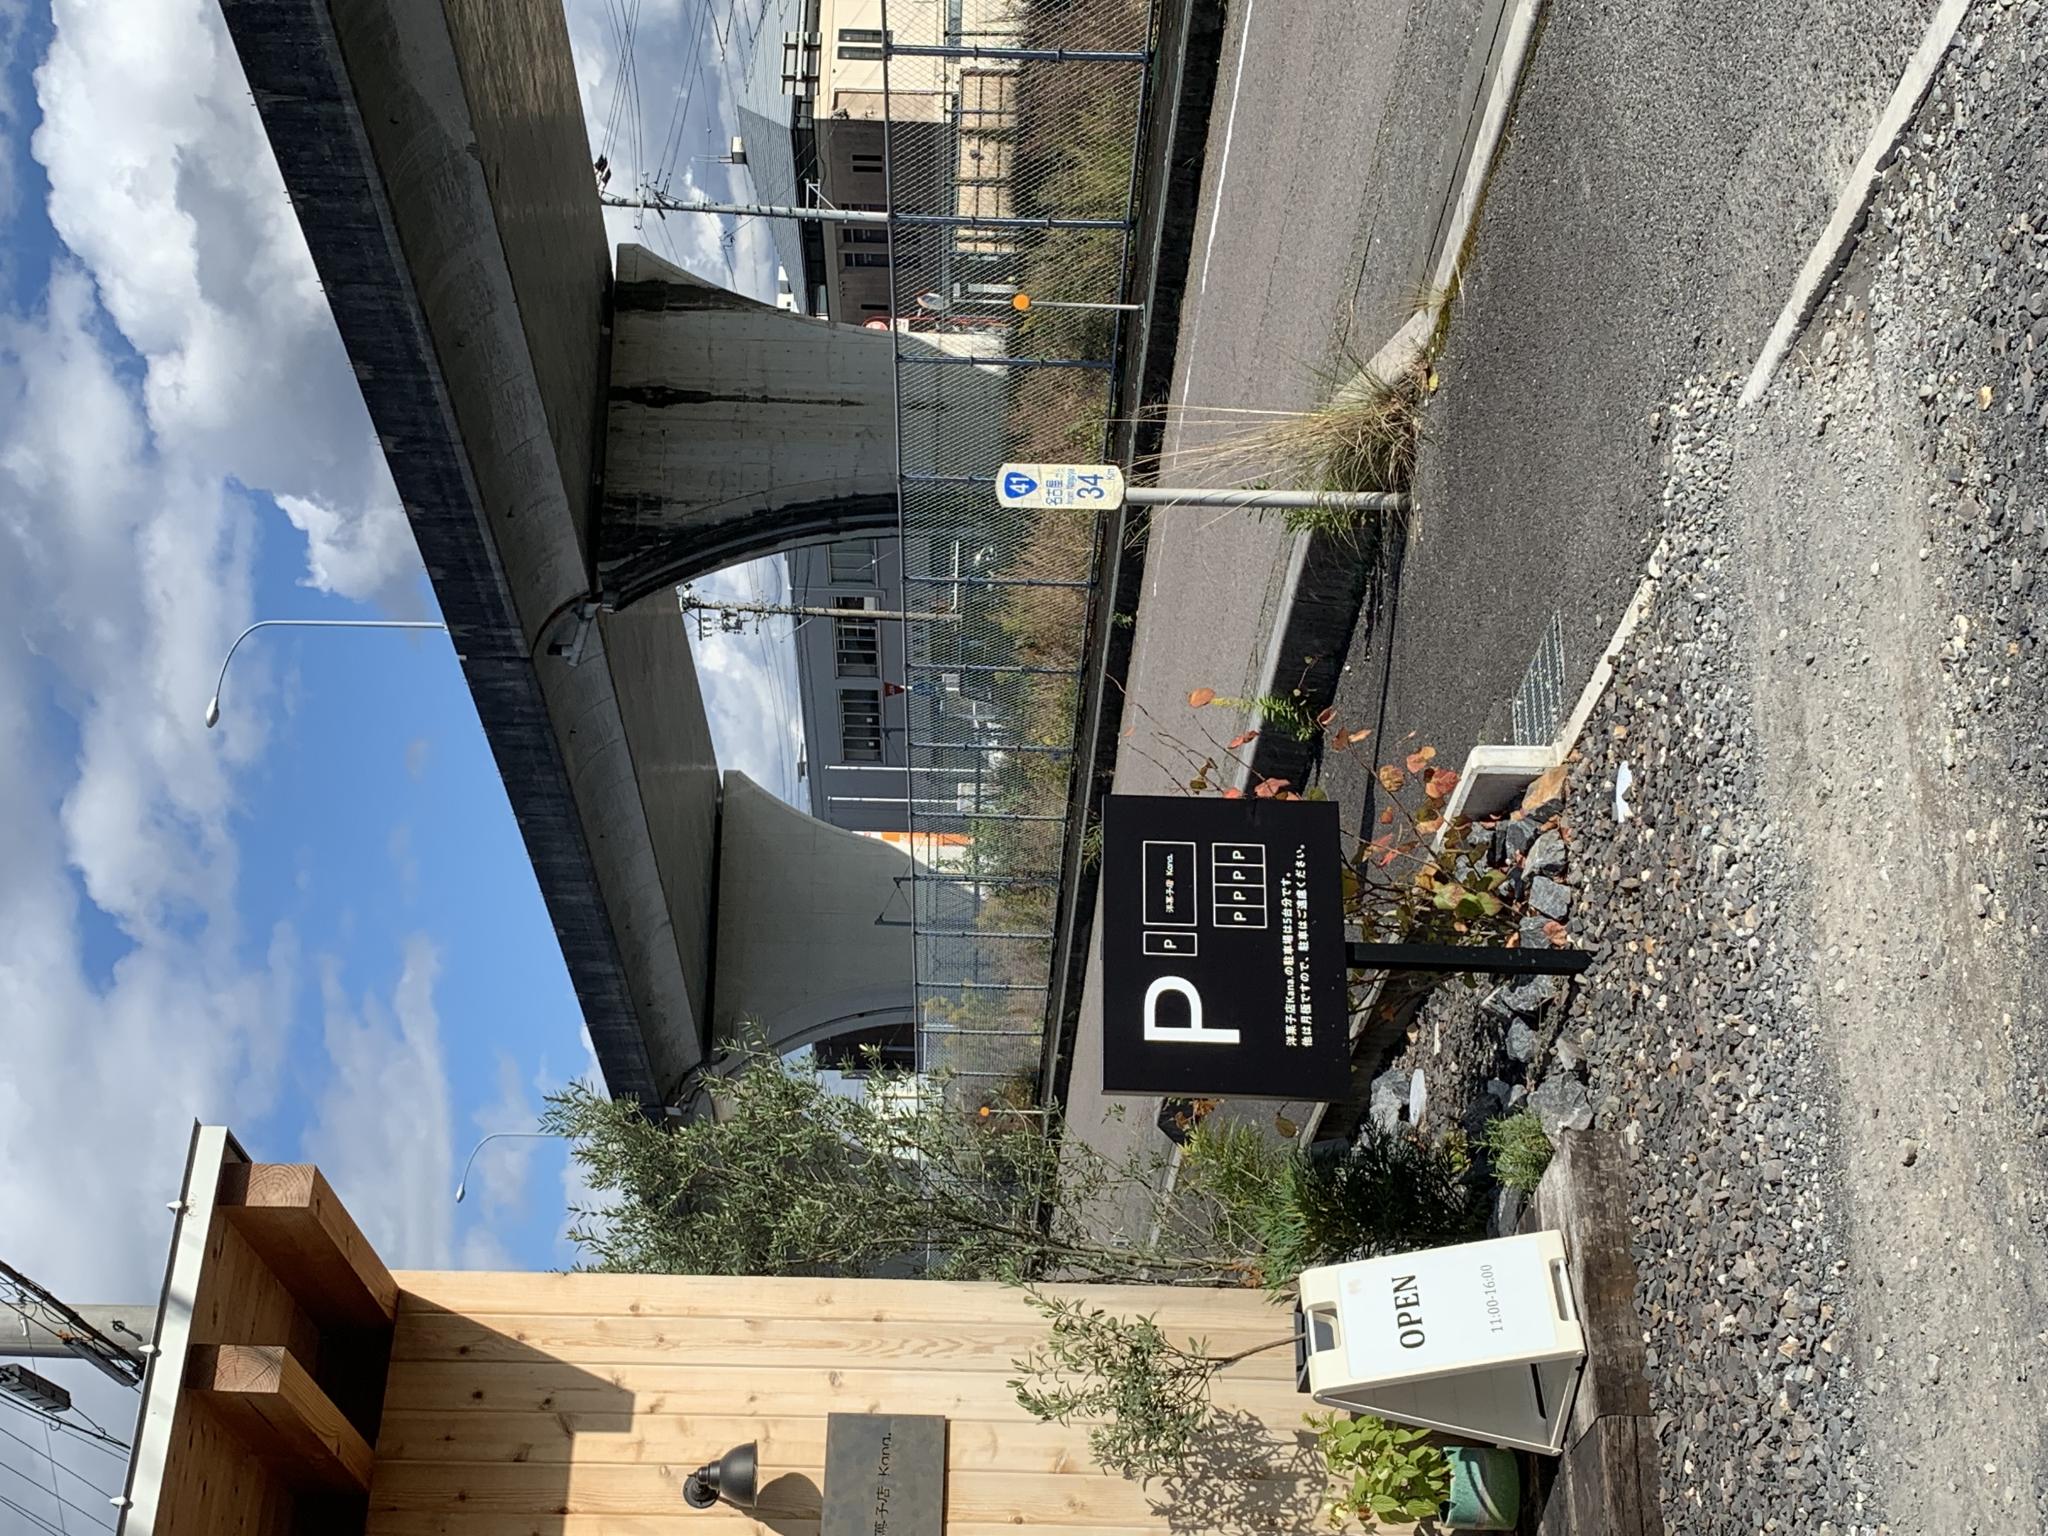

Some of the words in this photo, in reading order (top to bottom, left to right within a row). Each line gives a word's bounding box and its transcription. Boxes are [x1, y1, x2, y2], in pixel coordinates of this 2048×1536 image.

[1009, 477, 1030, 494] 41
[1076, 474, 1105, 499] 34
[1232, 850, 1245, 860] P
[1232, 871, 1246, 881] P
[1233, 891, 1246, 901] P
[1233, 911, 1247, 921] P
[1164, 939, 1177, 949] P
[1143, 975, 1241, 1045] P
[1480, 1264, 1504, 1334] 11:00-16:00
[1391, 1273, 1426, 1350] OPEN
